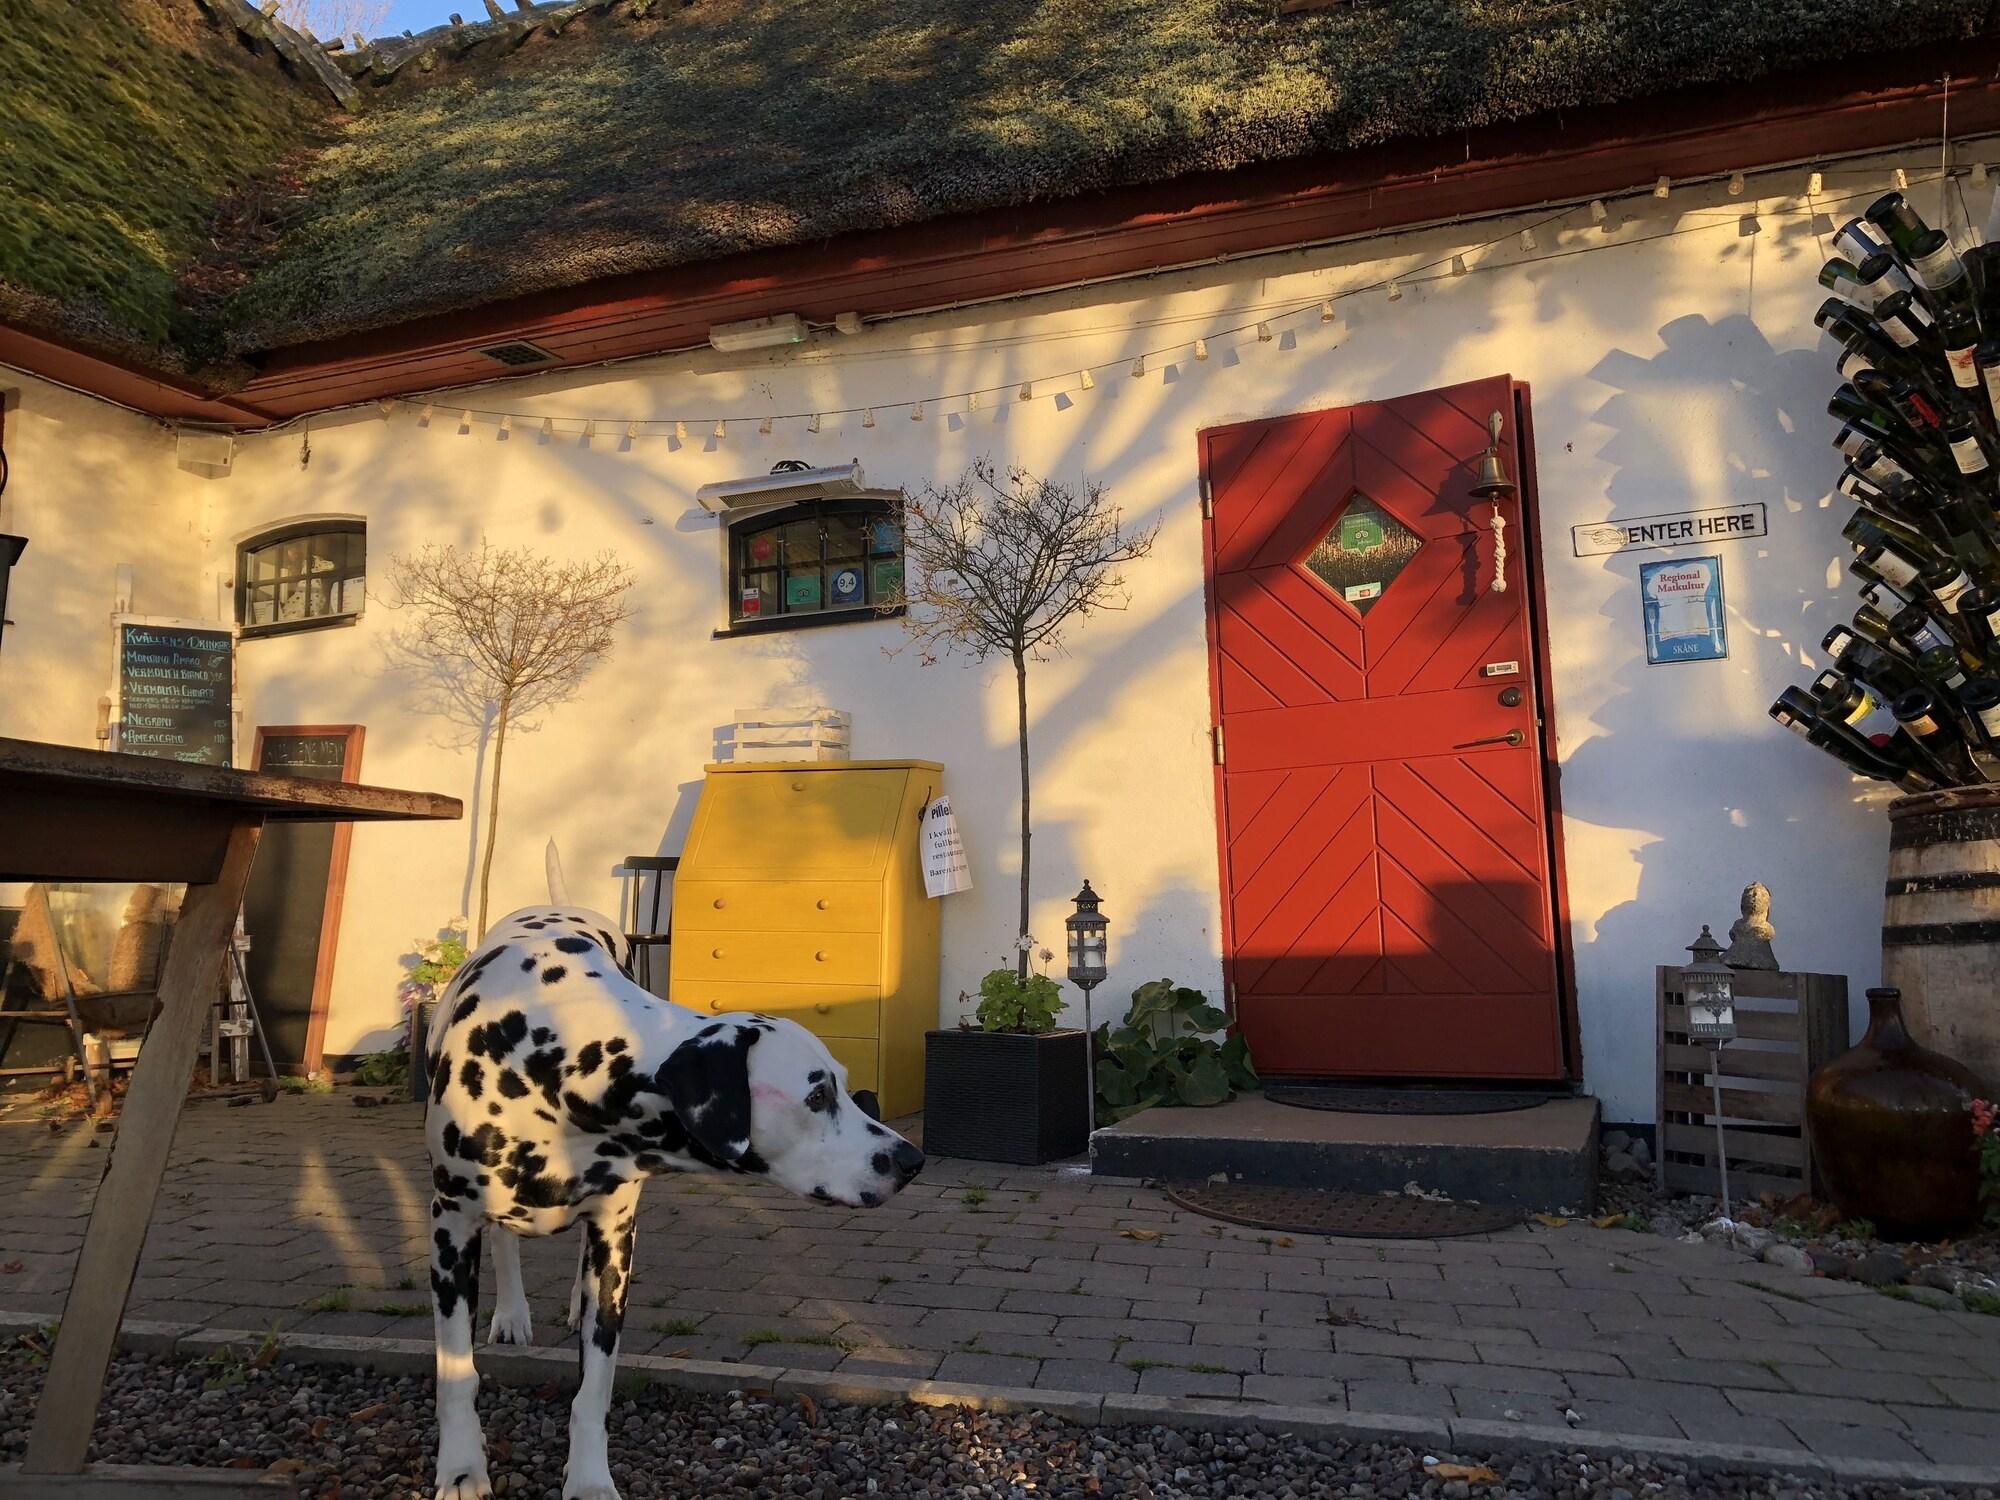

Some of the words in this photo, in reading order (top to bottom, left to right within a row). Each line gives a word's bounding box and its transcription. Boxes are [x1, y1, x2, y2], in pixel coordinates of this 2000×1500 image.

[1628, 519, 1693, 544] ENTER
[1699, 513, 1756, 536] HERE
[839, 576, 856, 589] 9,4
[1659, 570, 1701, 583] Regional
[1657, 581, 1706, 593] Matkultur
[1672, 643, 1700, 655] SKÅNE
